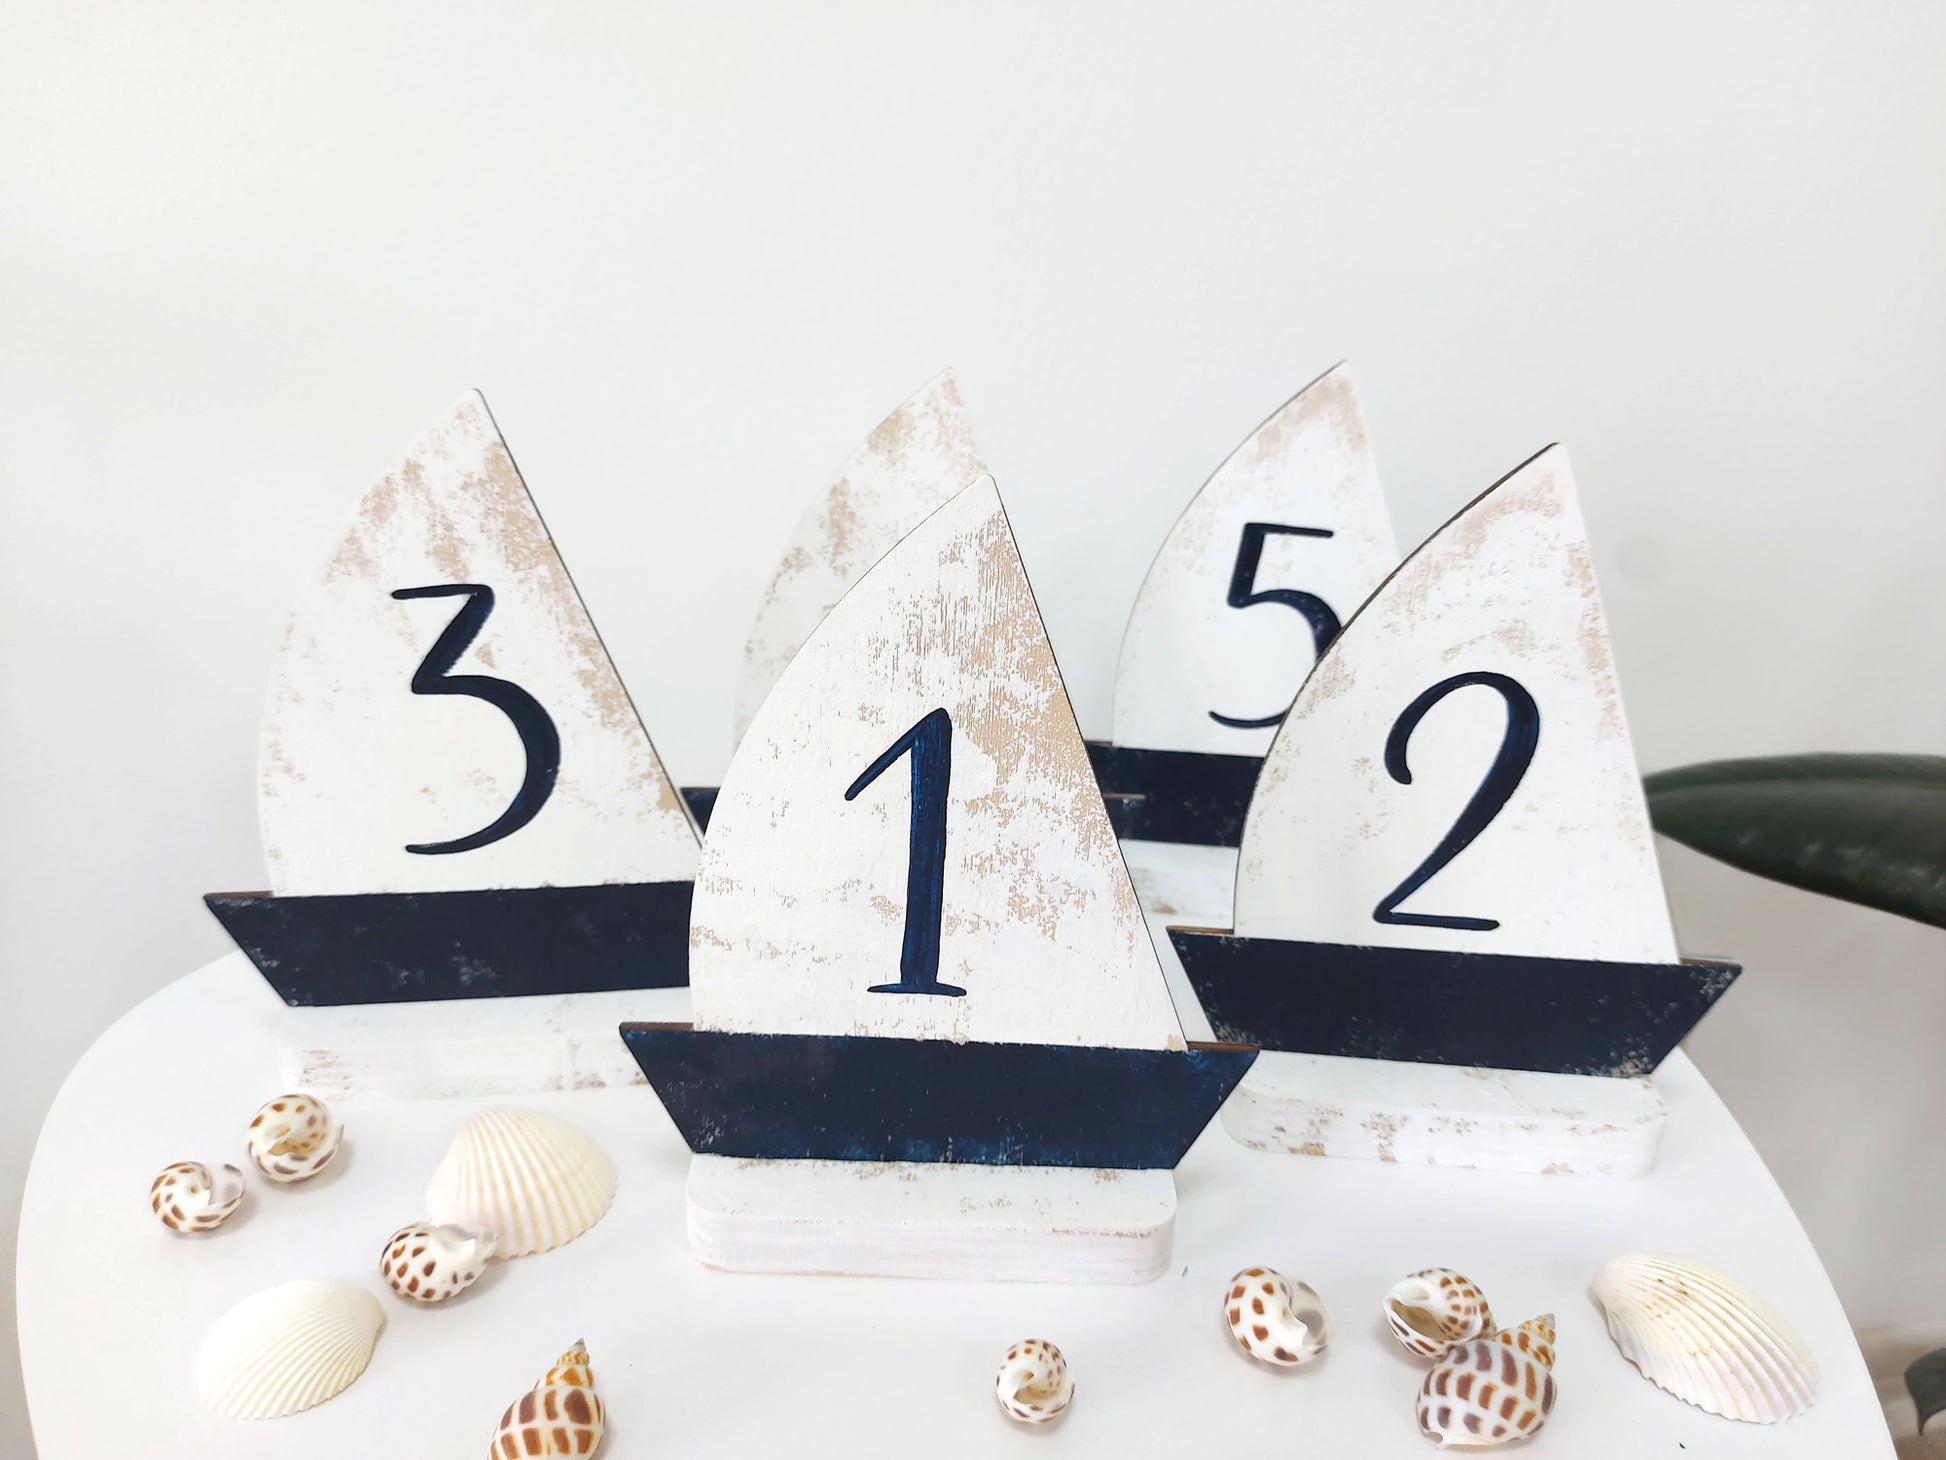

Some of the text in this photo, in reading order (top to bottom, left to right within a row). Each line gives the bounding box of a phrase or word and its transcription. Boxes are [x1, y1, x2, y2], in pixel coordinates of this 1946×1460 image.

[391, 584, 560, 855] 3
[1208, 522, 1342, 729] 5
[845, 708, 967, 997] 1
[1373, 671, 1540, 931] 2
